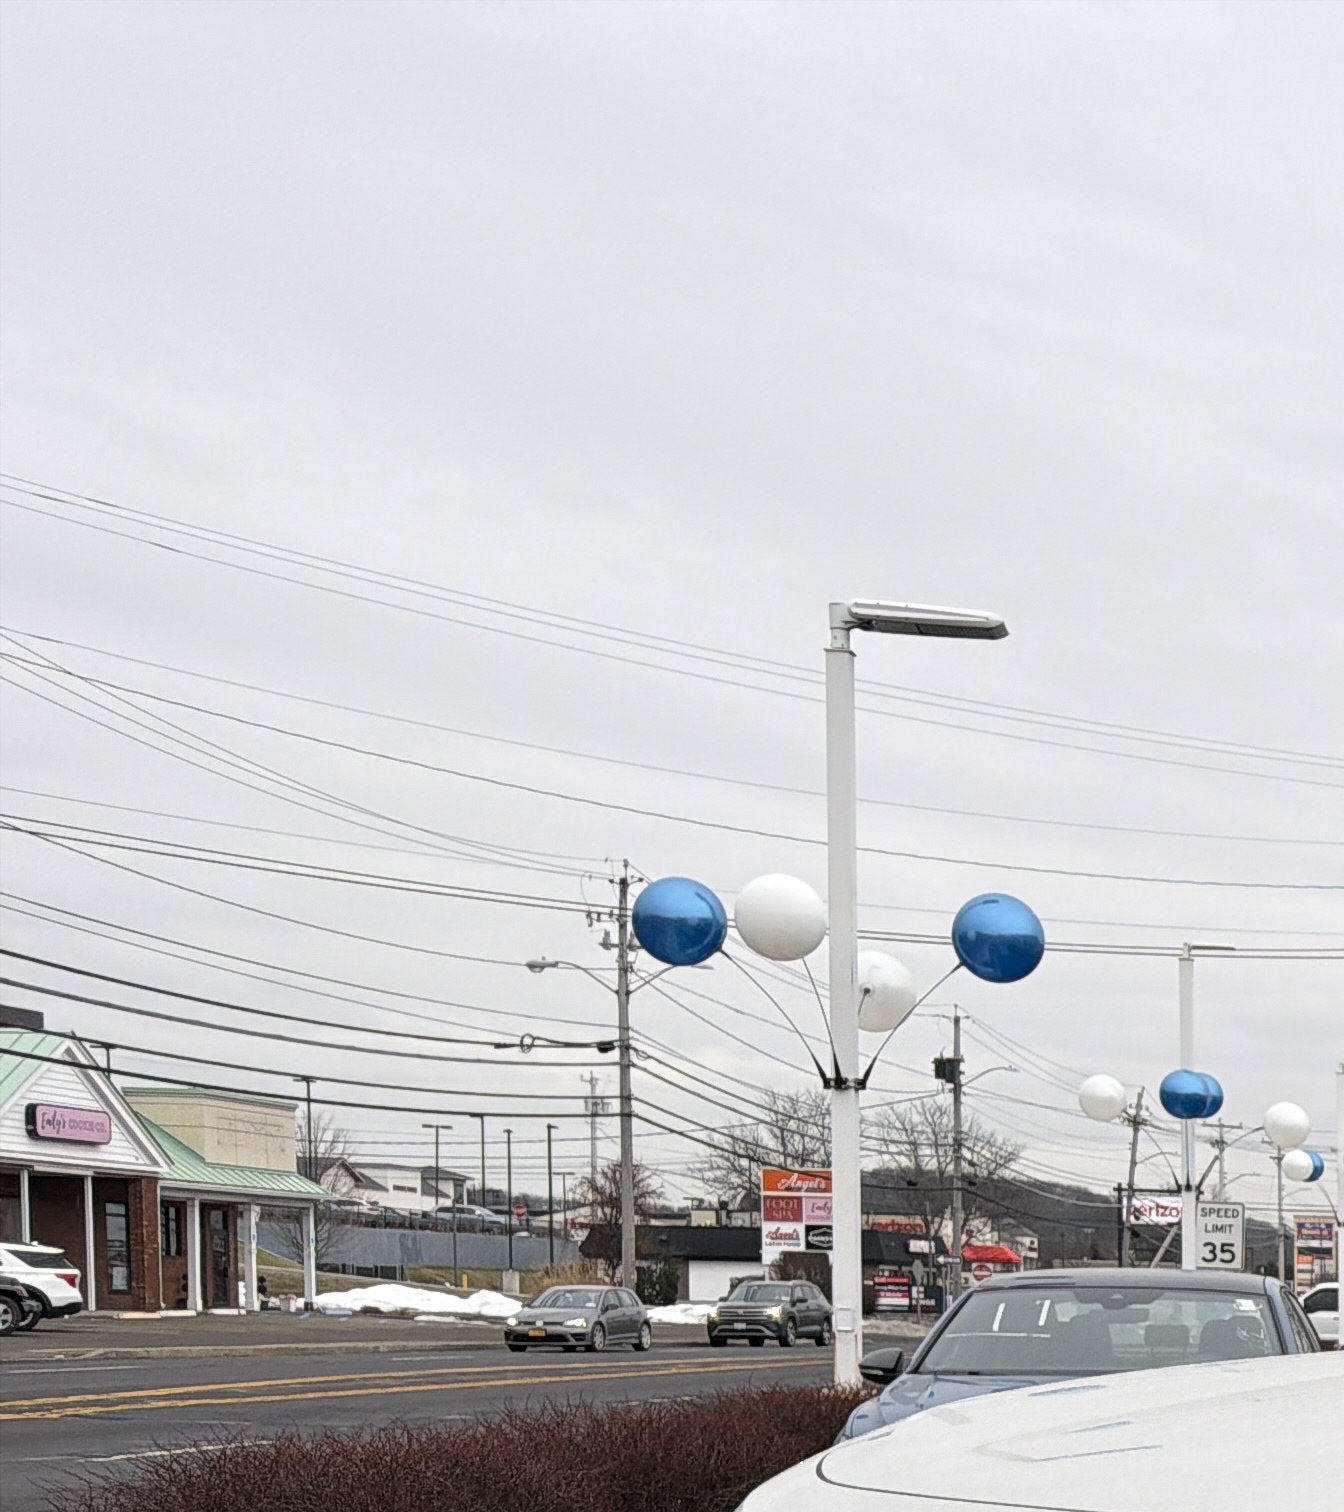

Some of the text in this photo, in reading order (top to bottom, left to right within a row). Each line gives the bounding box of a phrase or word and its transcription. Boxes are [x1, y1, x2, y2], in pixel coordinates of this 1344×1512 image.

[778, 1173, 826, 1192] Angel's
[766, 1199, 798, 1209] FOOT
[1130, 1202, 1183, 1218] verizo
[1200, 1207, 1240, 1219] SPEED
[1204, 1223, 1234, 1234] LIMIT
[1201, 1241, 1236, 1264] 35
